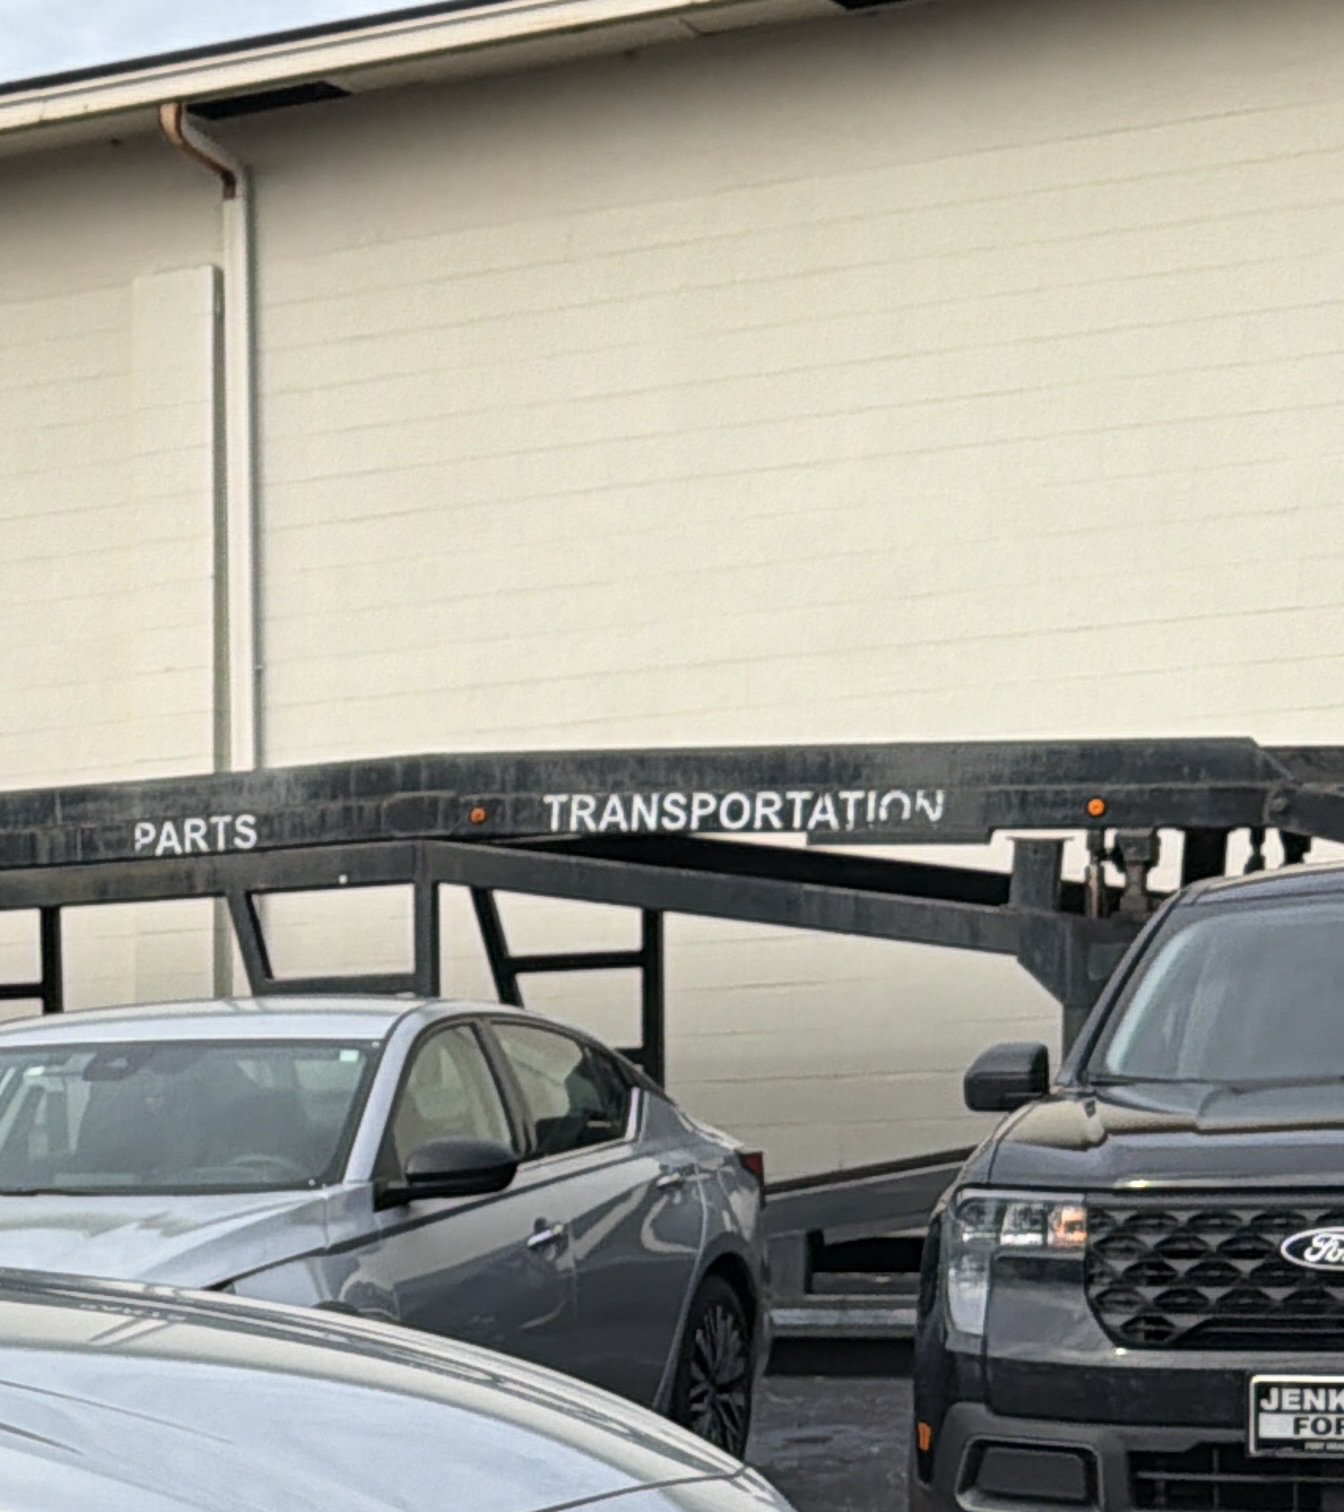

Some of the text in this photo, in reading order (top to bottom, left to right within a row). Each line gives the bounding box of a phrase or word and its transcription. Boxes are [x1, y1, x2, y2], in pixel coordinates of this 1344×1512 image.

[542, 789, 946, 833] TRANSPORTATION
[134, 814, 258, 857] PARTS
[1303, 1232, 1344, 1264] Fo
